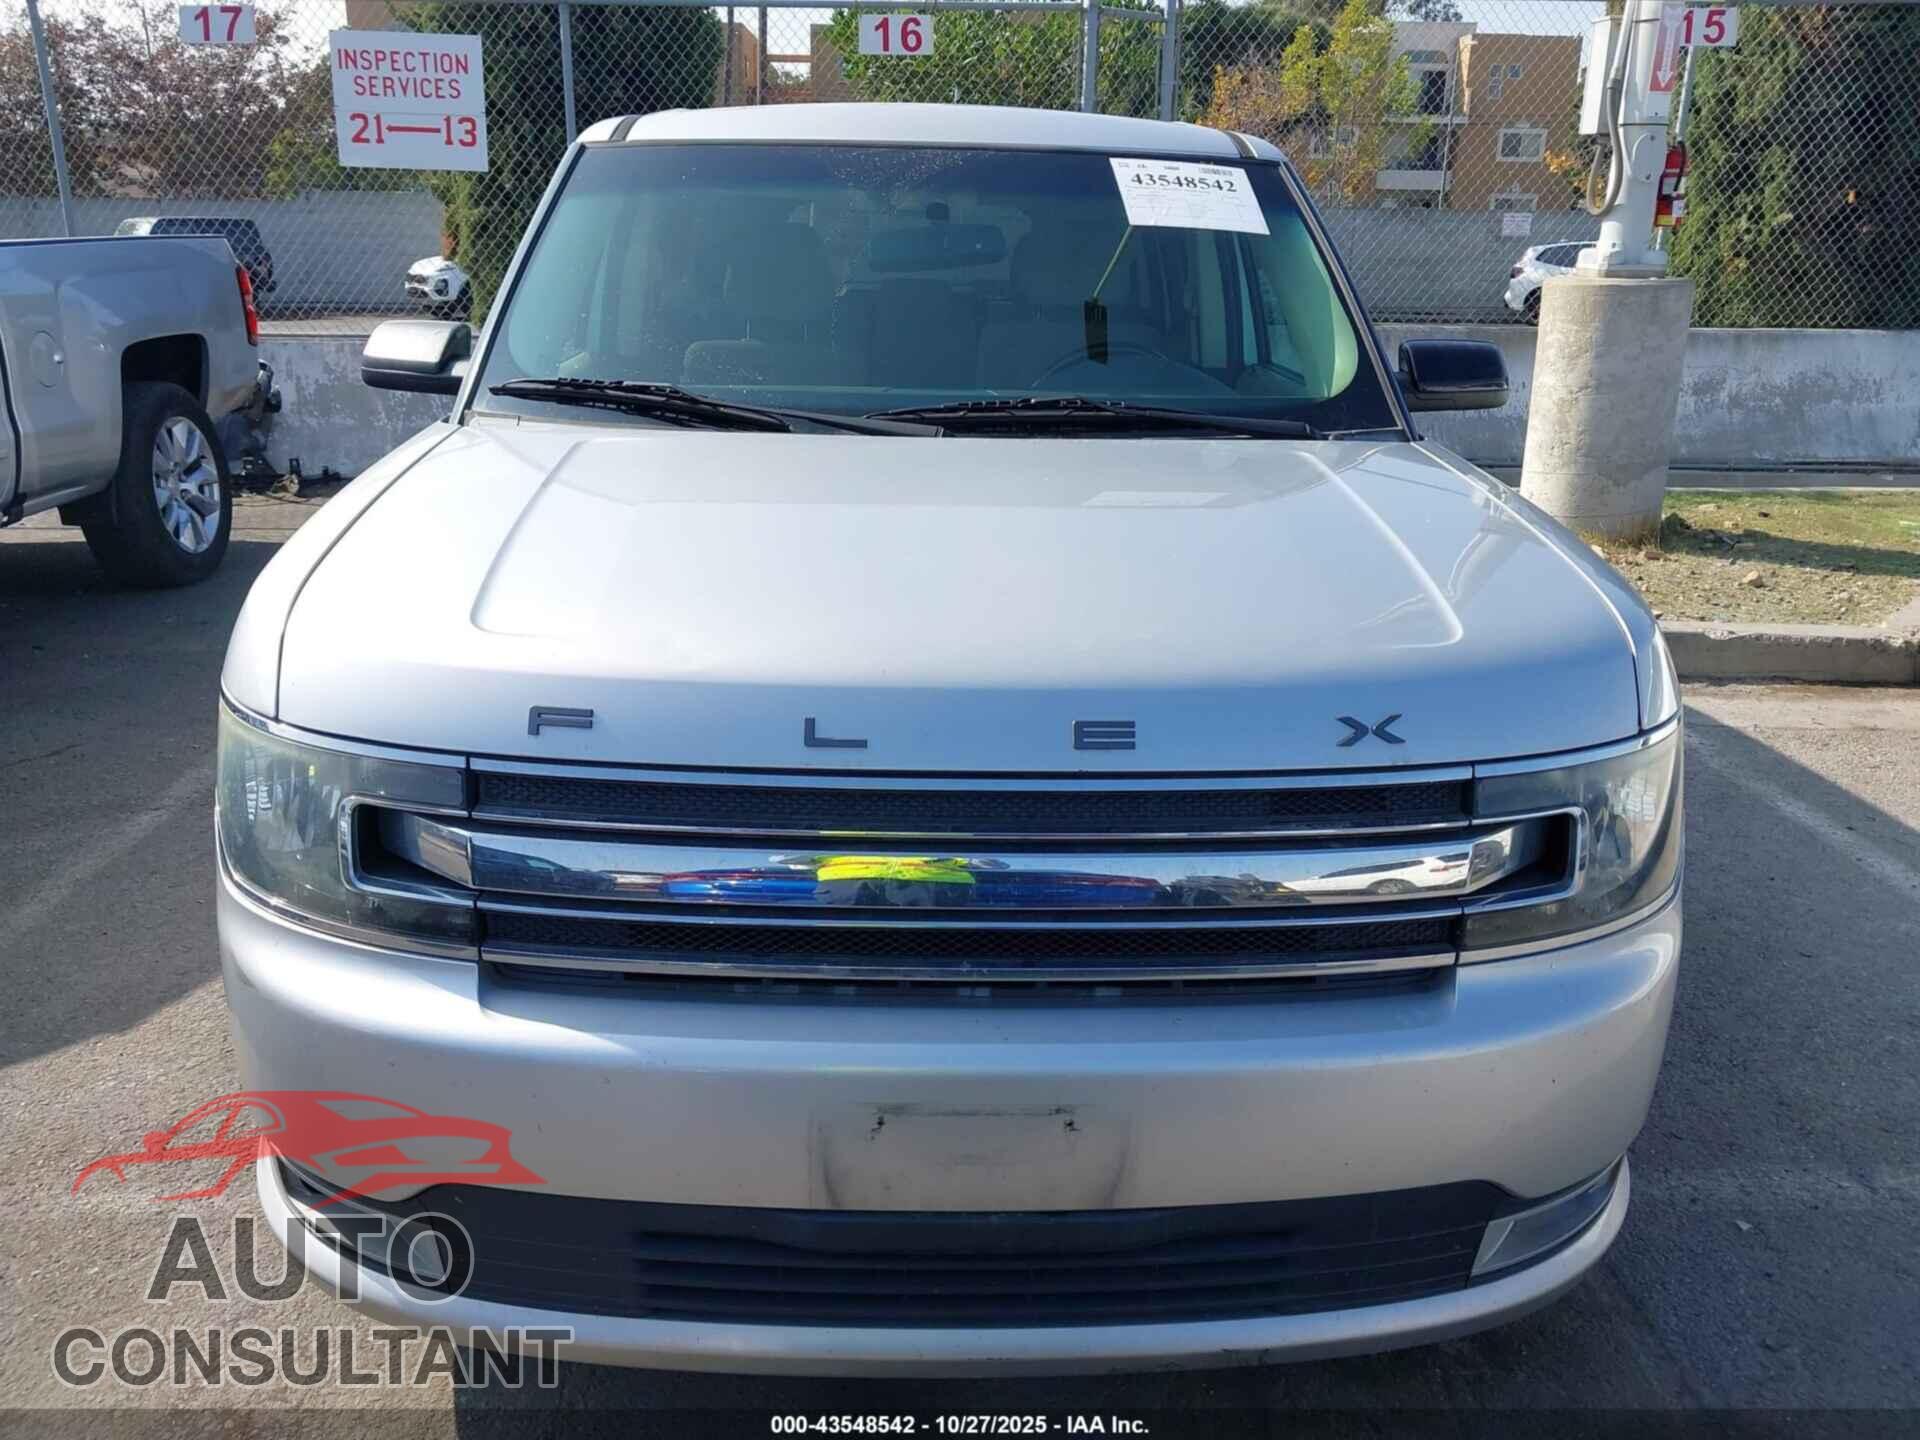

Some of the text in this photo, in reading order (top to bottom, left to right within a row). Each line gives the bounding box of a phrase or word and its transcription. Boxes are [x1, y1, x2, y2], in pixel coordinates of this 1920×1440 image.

[194, 6, 243, 42] 17
[874, 16, 923, 53] 16
[1683, 9, 1727, 45] 15
[338, 48, 470, 75] INSPECTION
[354, 77, 462, 99] SERVICES
[350, 113, 478, 147] 21 13
[1131, 173, 1237, 192] 43548542
[527, 705, 1406, 752] FLEX
